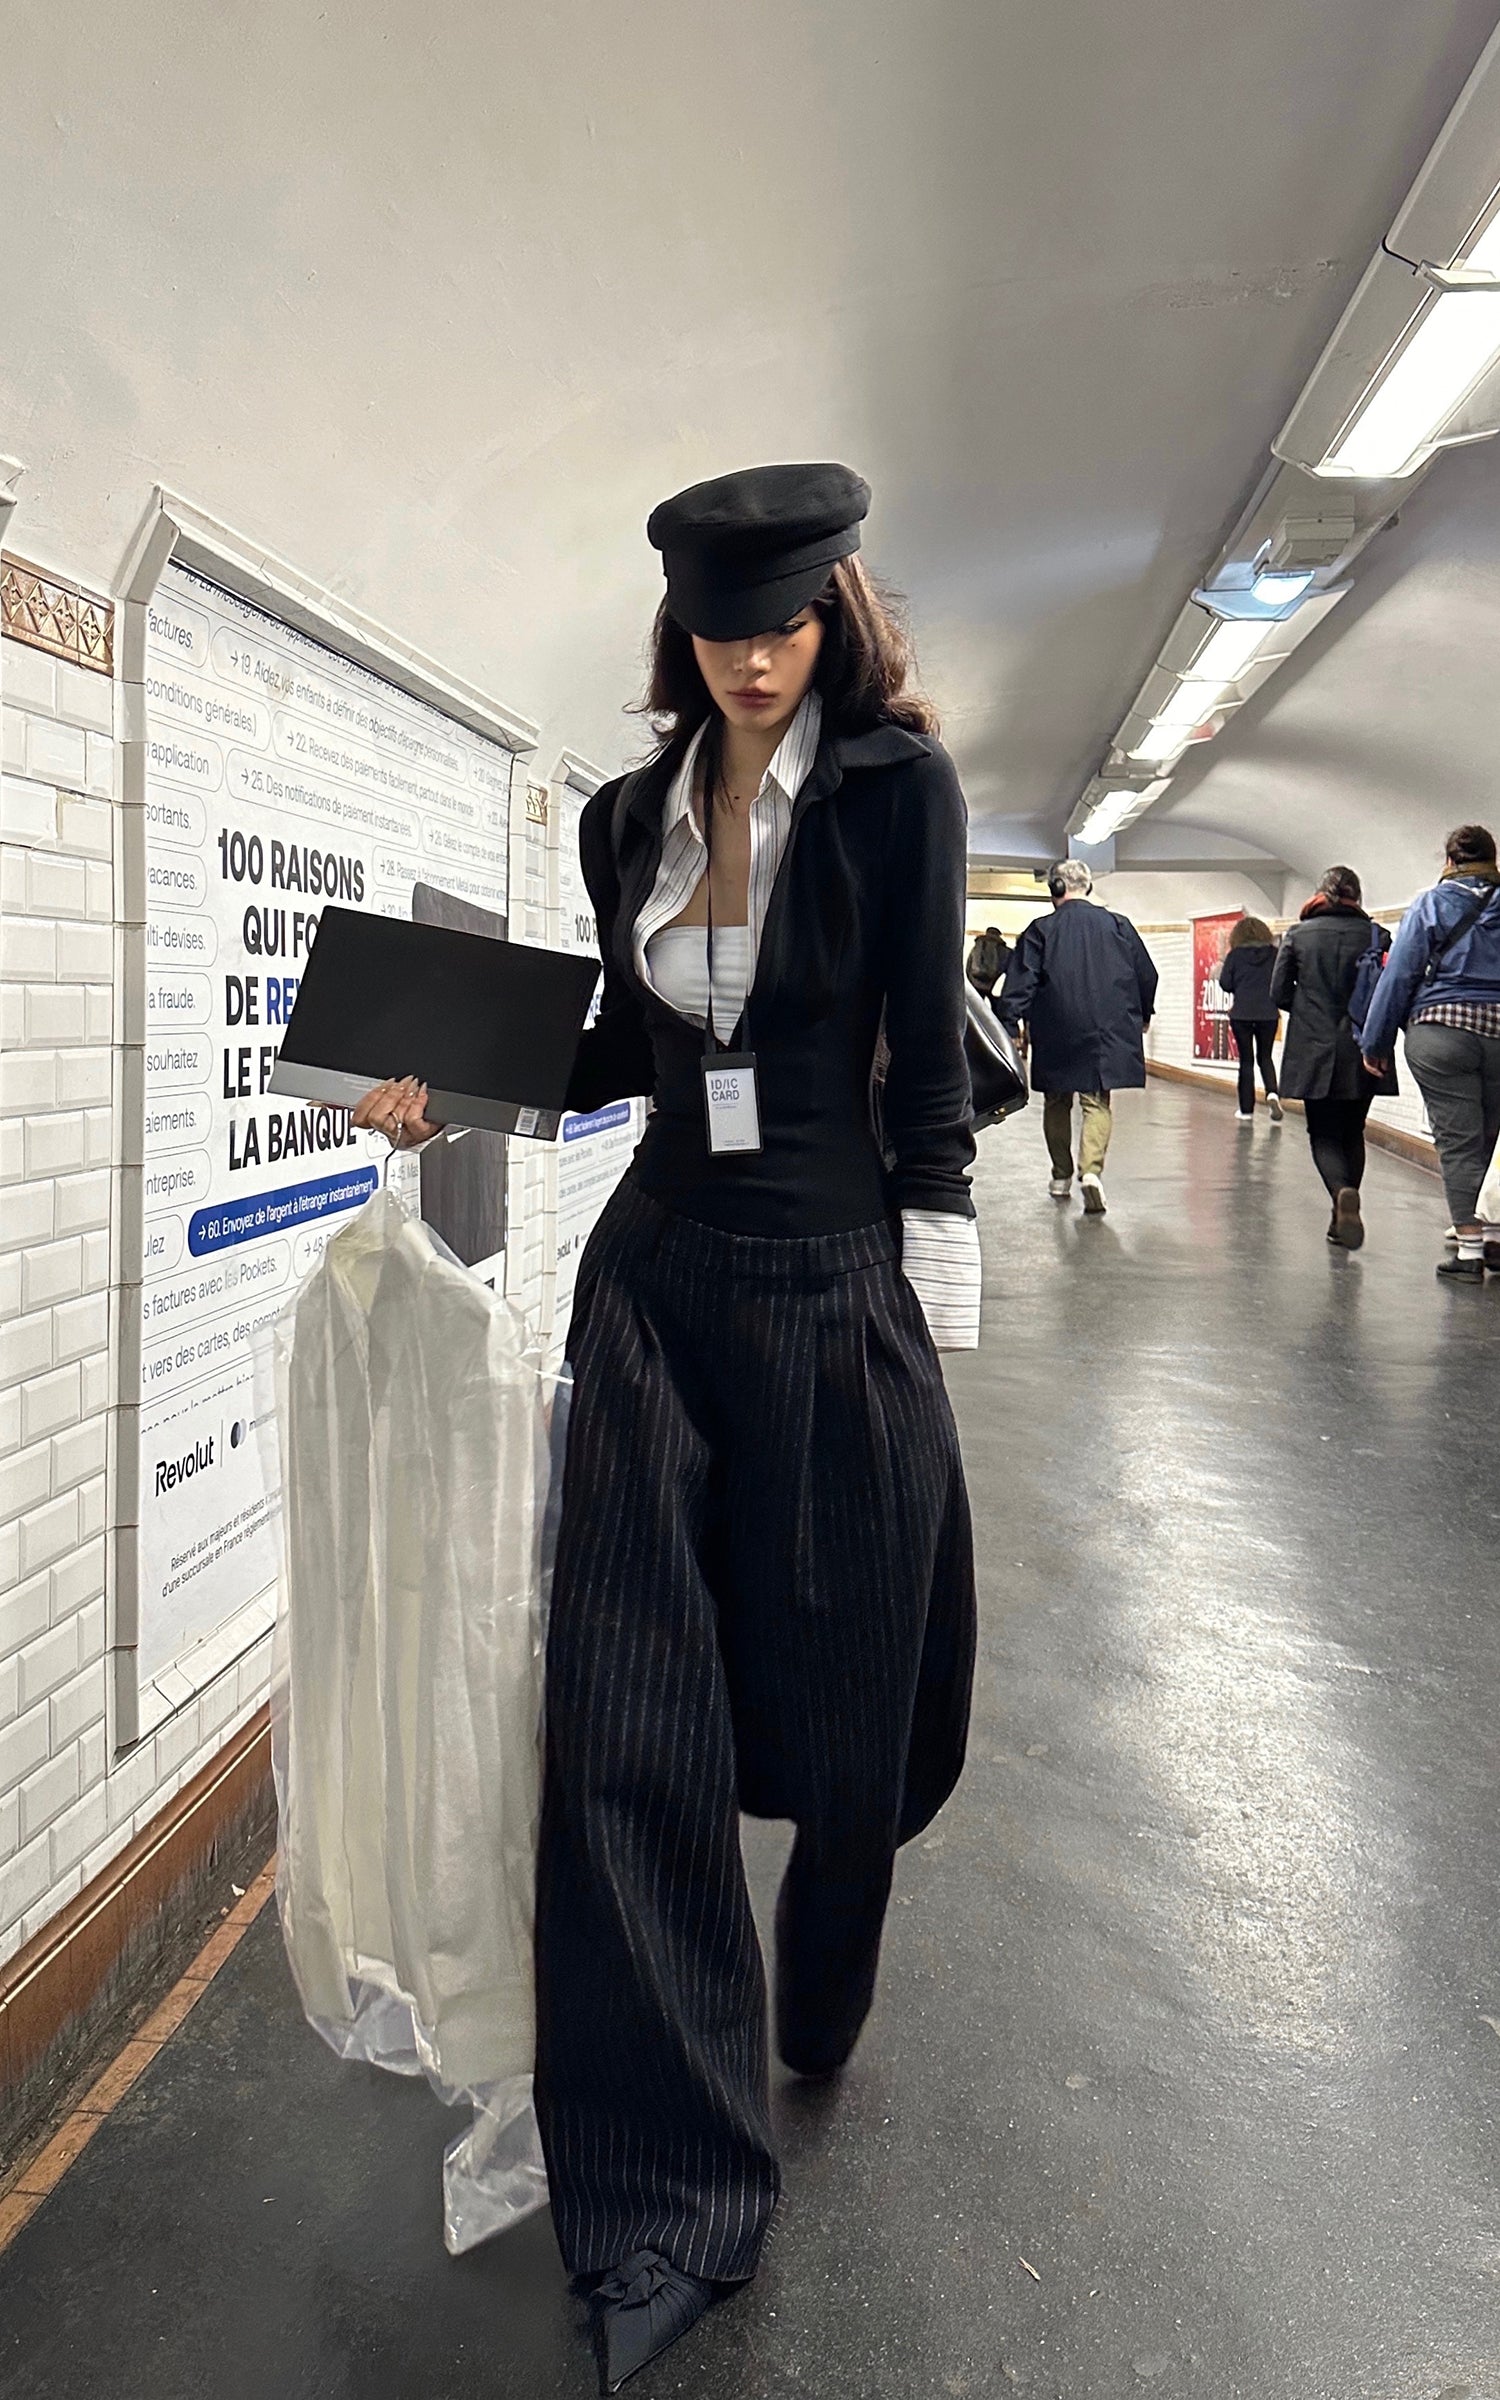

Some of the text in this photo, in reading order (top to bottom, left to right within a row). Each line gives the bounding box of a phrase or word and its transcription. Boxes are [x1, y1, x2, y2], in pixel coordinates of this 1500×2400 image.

[146, 677, 257, 738] conditions générales.)
[254, 659, 281, 689] Aidez
[296, 684, 326, 710] enfants
[369, 716, 397, 743] objectifs
[308, 737, 340, 766] Recevez
[251, 769, 264, 792] 25.
[266, 774, 283, 798] Des
[285, 783, 331, 812] notifications
[332, 796, 342, 815] de
[218, 828, 365, 903] 100 RAISONS
[243, 905, 286, 957] QUI
[575, 913, 591, 944] 100
[158, 986, 196, 1009] fraude.
[225, 975, 259, 1026] DE
[146, 1047, 198, 1072] souhaitez
[223, 1047, 252, 1099] LE
[710, 1078, 739, 1090] ID/IC
[711, 1090, 740, 1102] CARD
[229, 1116, 261, 1171] LA
[207, 1219, 221, 1240] 60.
[222, 1215, 255, 1236] Envoyez
[254, 1210, 267, 1226] de
[266, 1202, 294, 1225] l'argent
[293, 1199, 299, 1214] à
[151, 1285, 197, 1317] factures
[198, 1275, 223, 1300] avec
[239, 1255, 278, 1285] Pockets.
[149, 1355, 173, 1380] vers
[175, 1345, 195, 1369] des
[197, 1331, 231, 1358] cartes,
[232, 1320, 251, 1343] des
[155, 1435, 214, 1497] Revolut
[161, 1576, 181, 1598] d'une
[181, 1551, 214, 1584] succursale
[214, 1545, 223, 1560] en
[223, 1531, 243, 1553] France
[171, 1541, 197, 1572] Réservé
[197, 1536, 209, 1553] aux
[209, 1520, 233, 1545] majeurs
